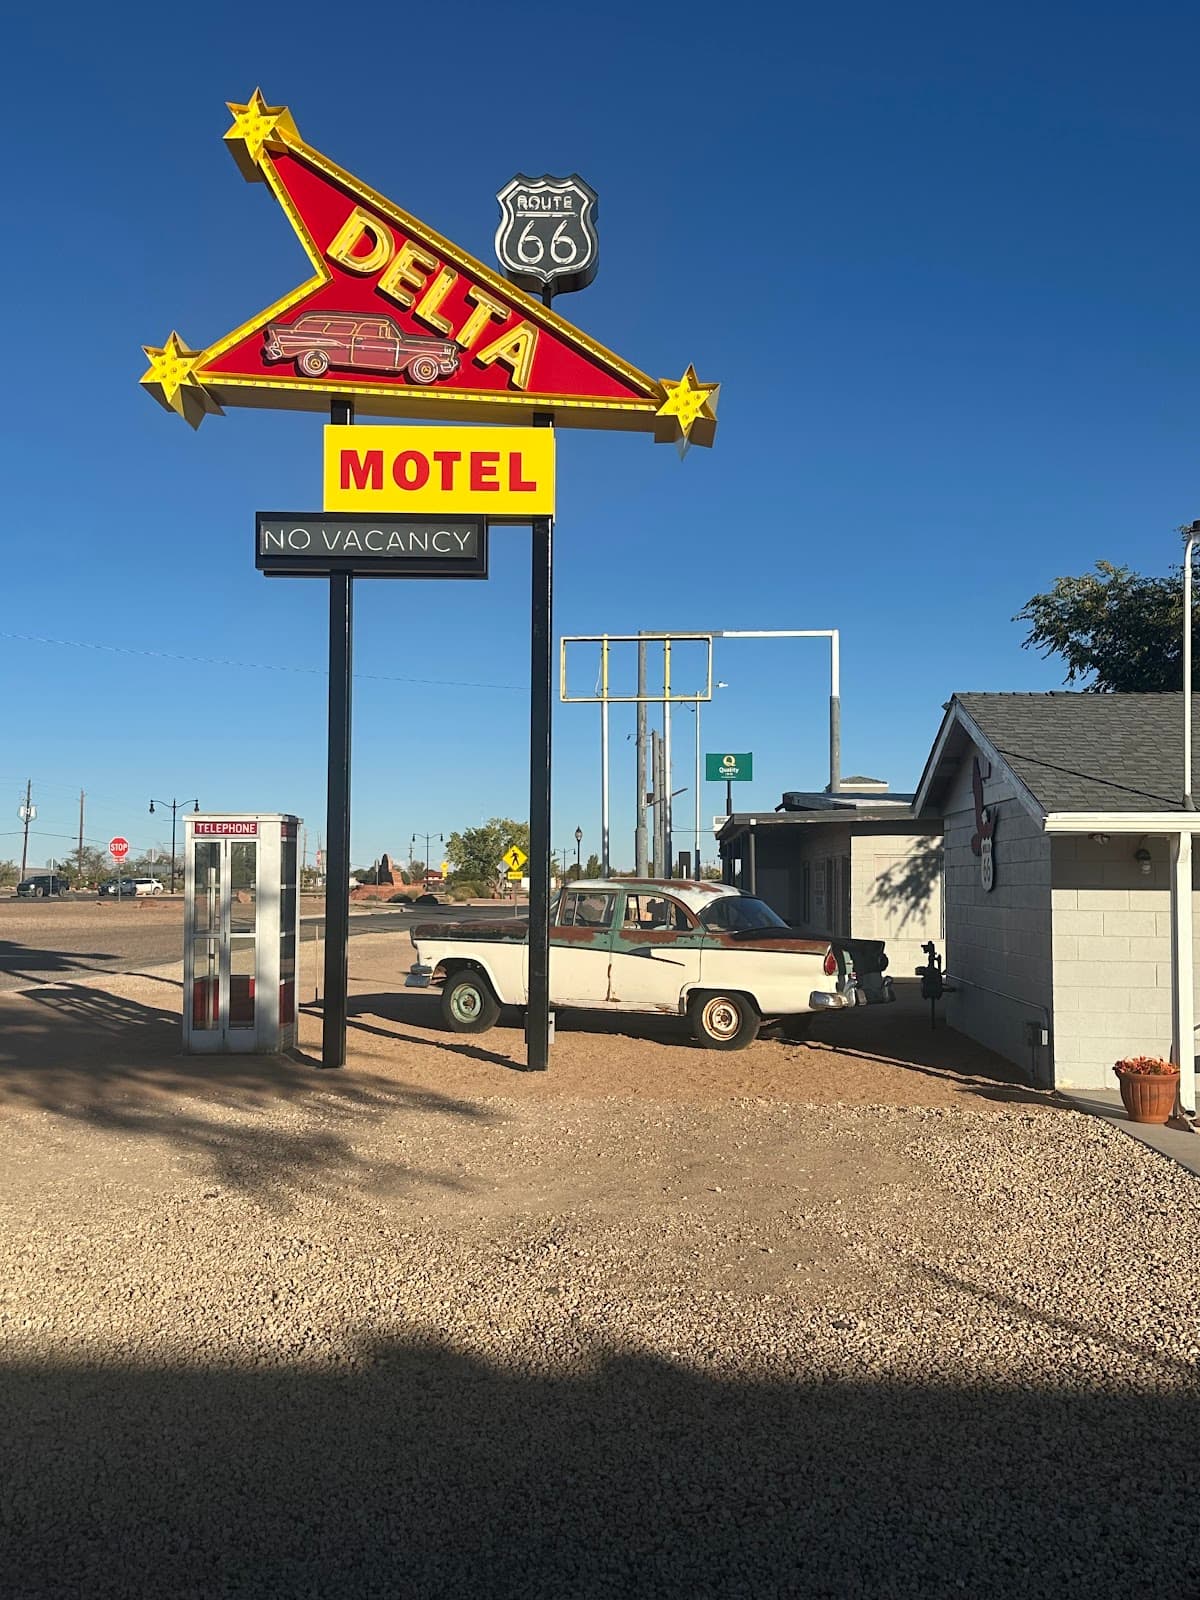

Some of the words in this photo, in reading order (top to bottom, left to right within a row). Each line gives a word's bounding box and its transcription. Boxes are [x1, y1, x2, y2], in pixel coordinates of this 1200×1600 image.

[517, 195, 573, 210] ROUTE
[517, 220, 577, 264] 66
[326, 206, 539, 391] DELTA
[340, 450, 537, 492] MOTEL
[265, 528, 311, 550] NO
[321, 529, 472, 553] VACANCY
[196, 823, 256, 834] TELEPHONE
[110, 843, 128, 852] STOP
